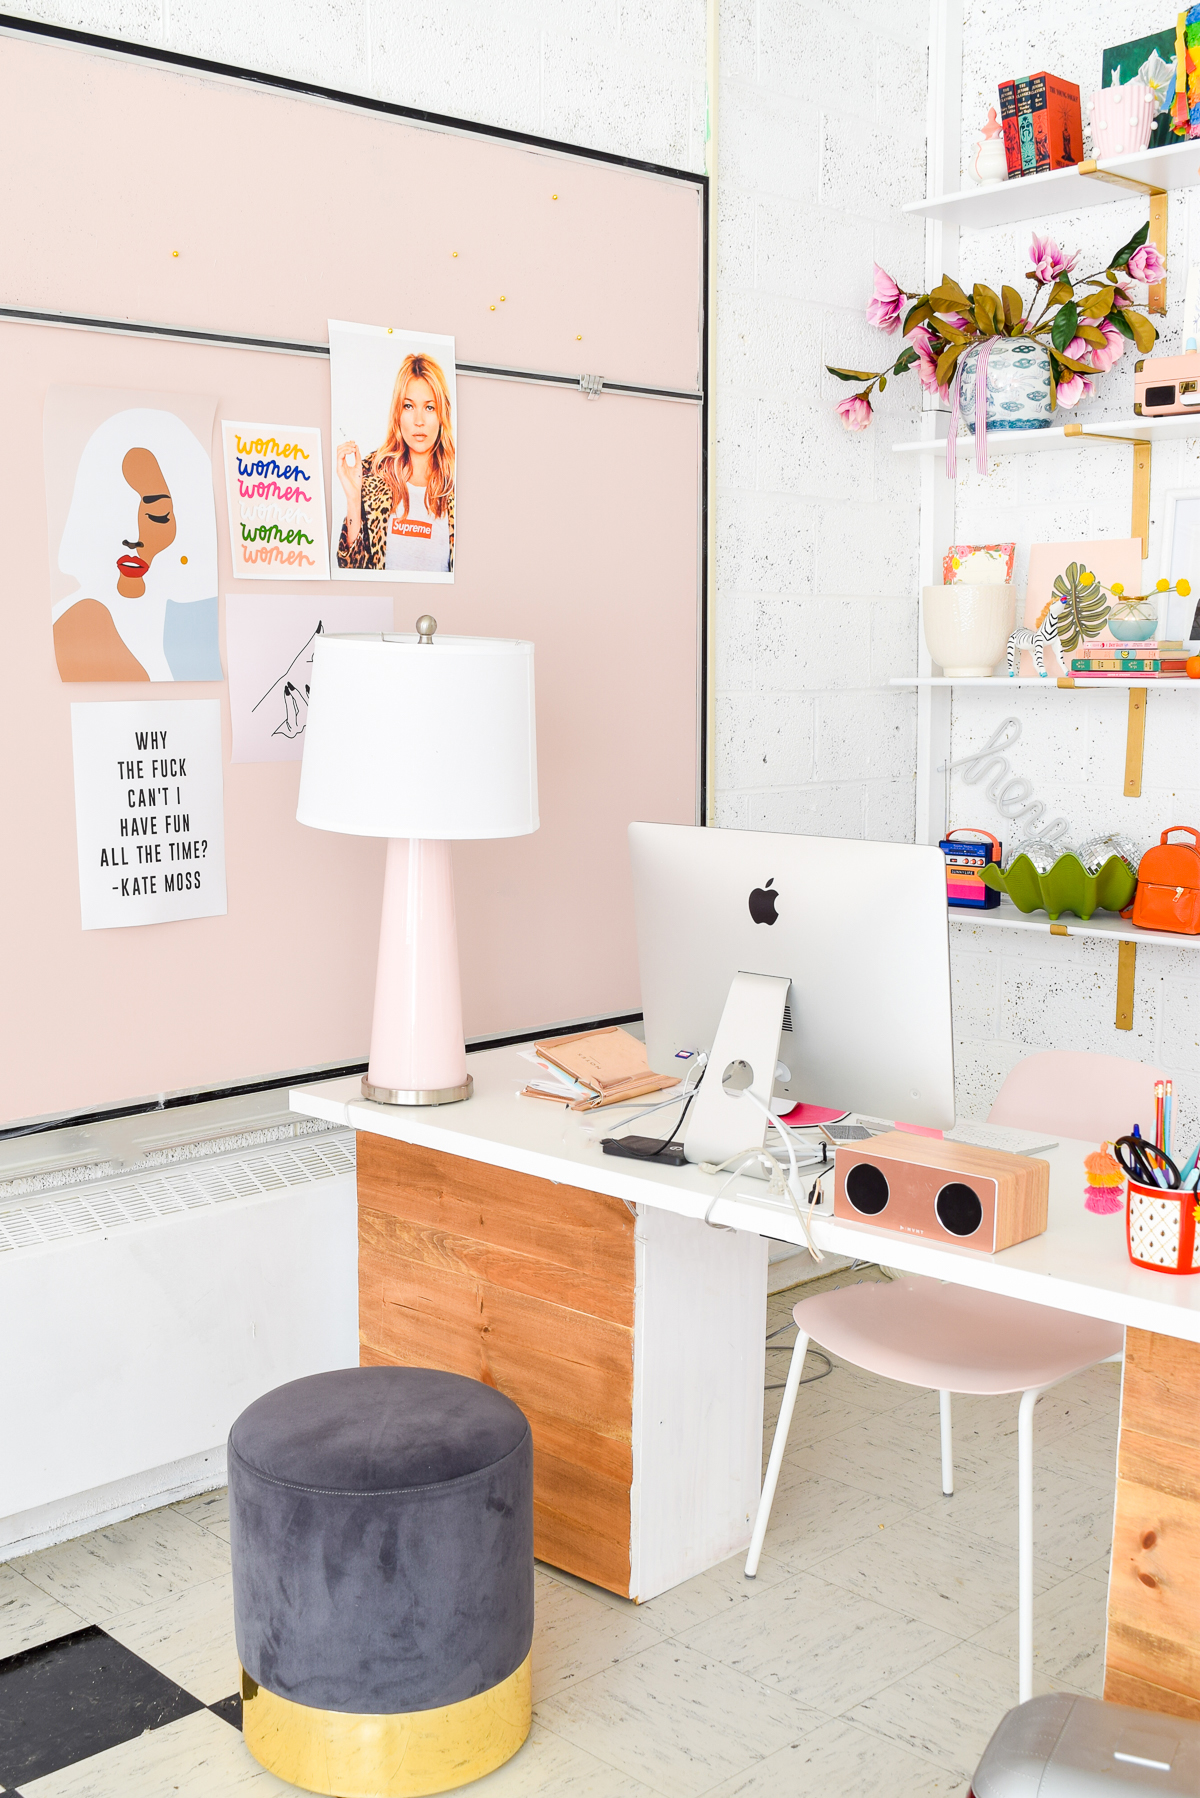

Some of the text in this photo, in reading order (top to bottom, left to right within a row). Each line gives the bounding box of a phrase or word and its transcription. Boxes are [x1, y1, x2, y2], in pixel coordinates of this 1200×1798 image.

[234, 434, 310, 460] women
[236, 456, 311, 481] women
[237, 478, 312, 503] women
[239, 500, 313, 525] women
[240, 522, 314, 546] women
[393, 520, 431, 534] Supreme
[241, 544, 316, 567] women
[135, 730, 168, 750] WHY
[117, 758, 187, 780] THE FUCK
[127, 786, 181, 808] CAN'T I
[120, 813, 190, 837] HAVE FUN
[100, 839, 208, 867] ALL THE TIME?
[112, 870, 201, 897] -KATE MOSS
